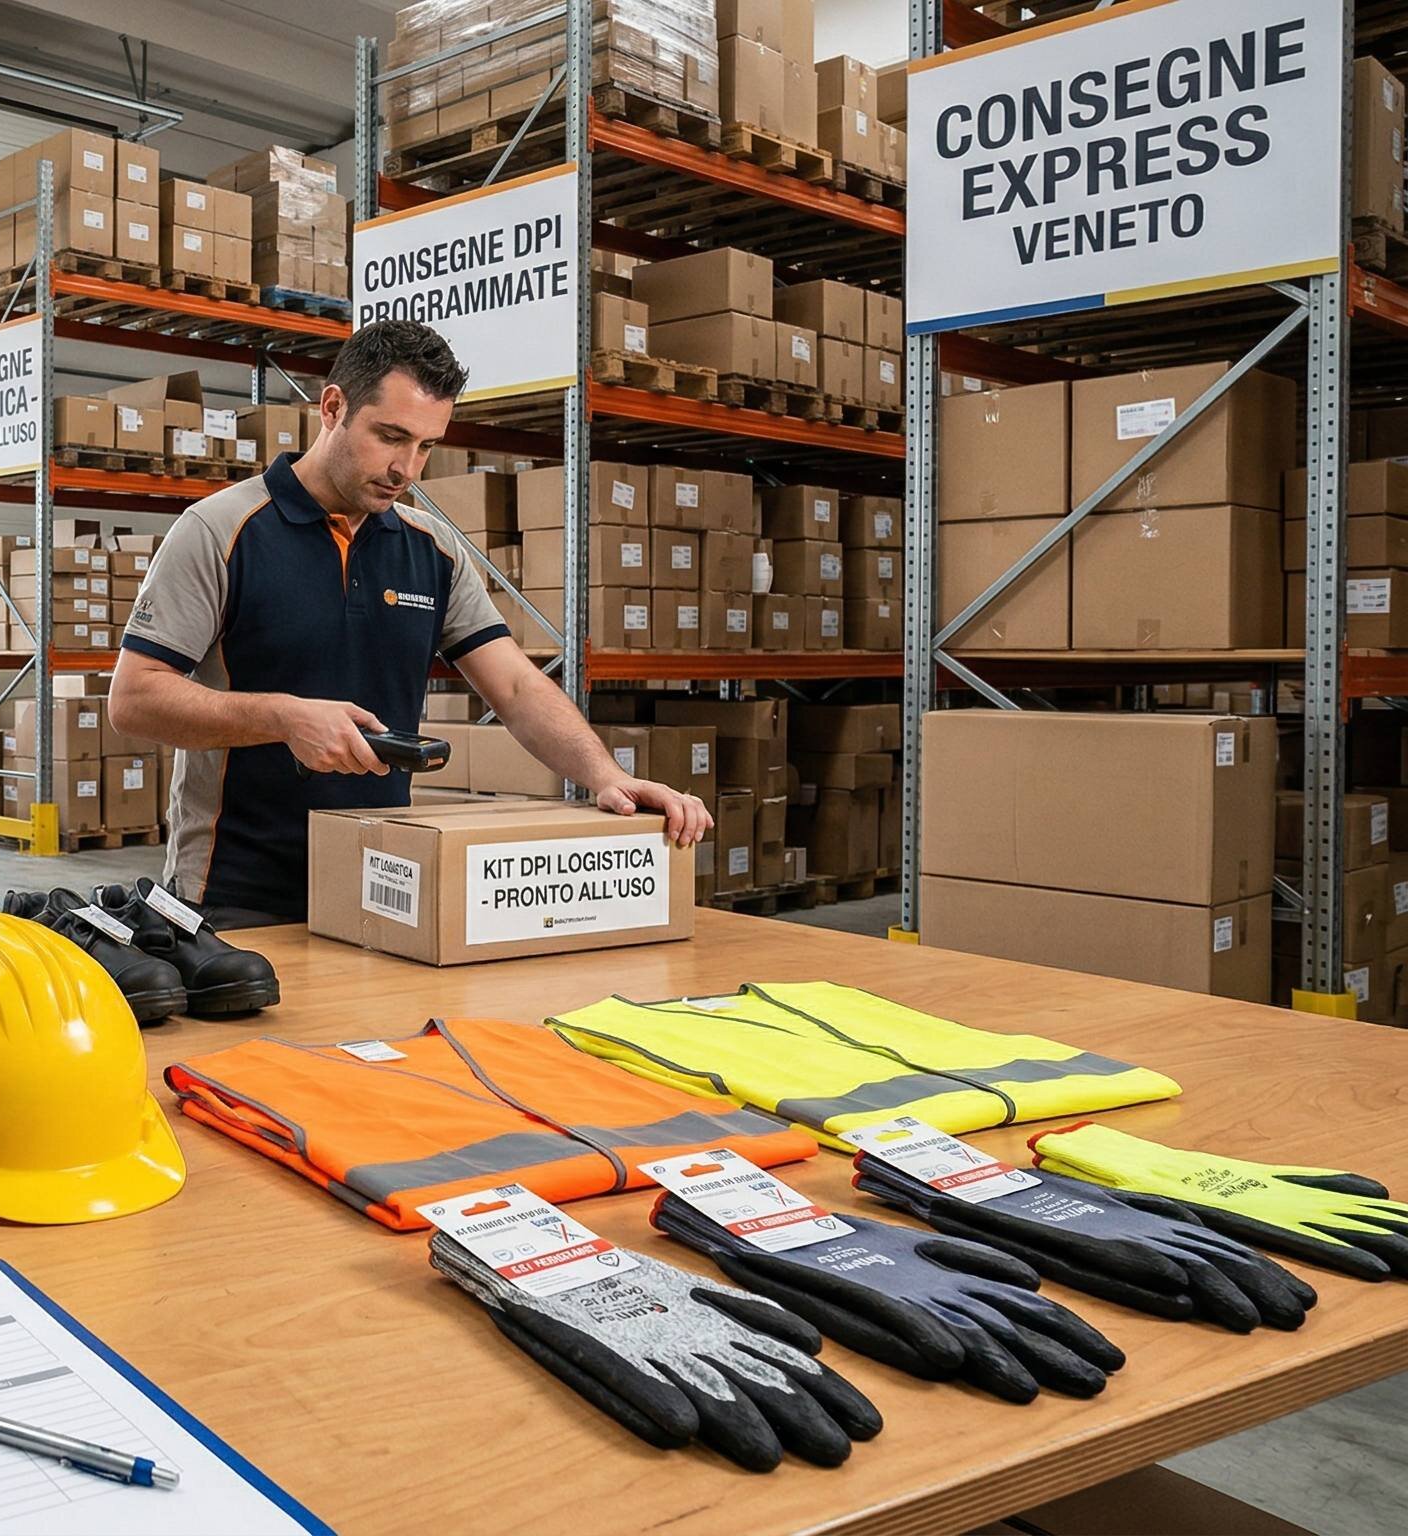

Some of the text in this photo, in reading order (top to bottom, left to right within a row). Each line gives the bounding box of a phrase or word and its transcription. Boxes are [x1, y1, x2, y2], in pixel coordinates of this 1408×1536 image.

[935, 17, 1306, 160] CONSEGNE
[962, 104, 1271, 221] EXPRESS
[364, 214, 562, 293] CONSEGNE DPI
[1012, 193, 1205, 266] VENETO
[360, 260, 568, 328] PROGRAMMATE
[483, 848, 655, 879] KIT DPI LOGISTICA
[494, 883, 574, 909] PRONTO
[578, 876, 656, 902] ALL'USO
